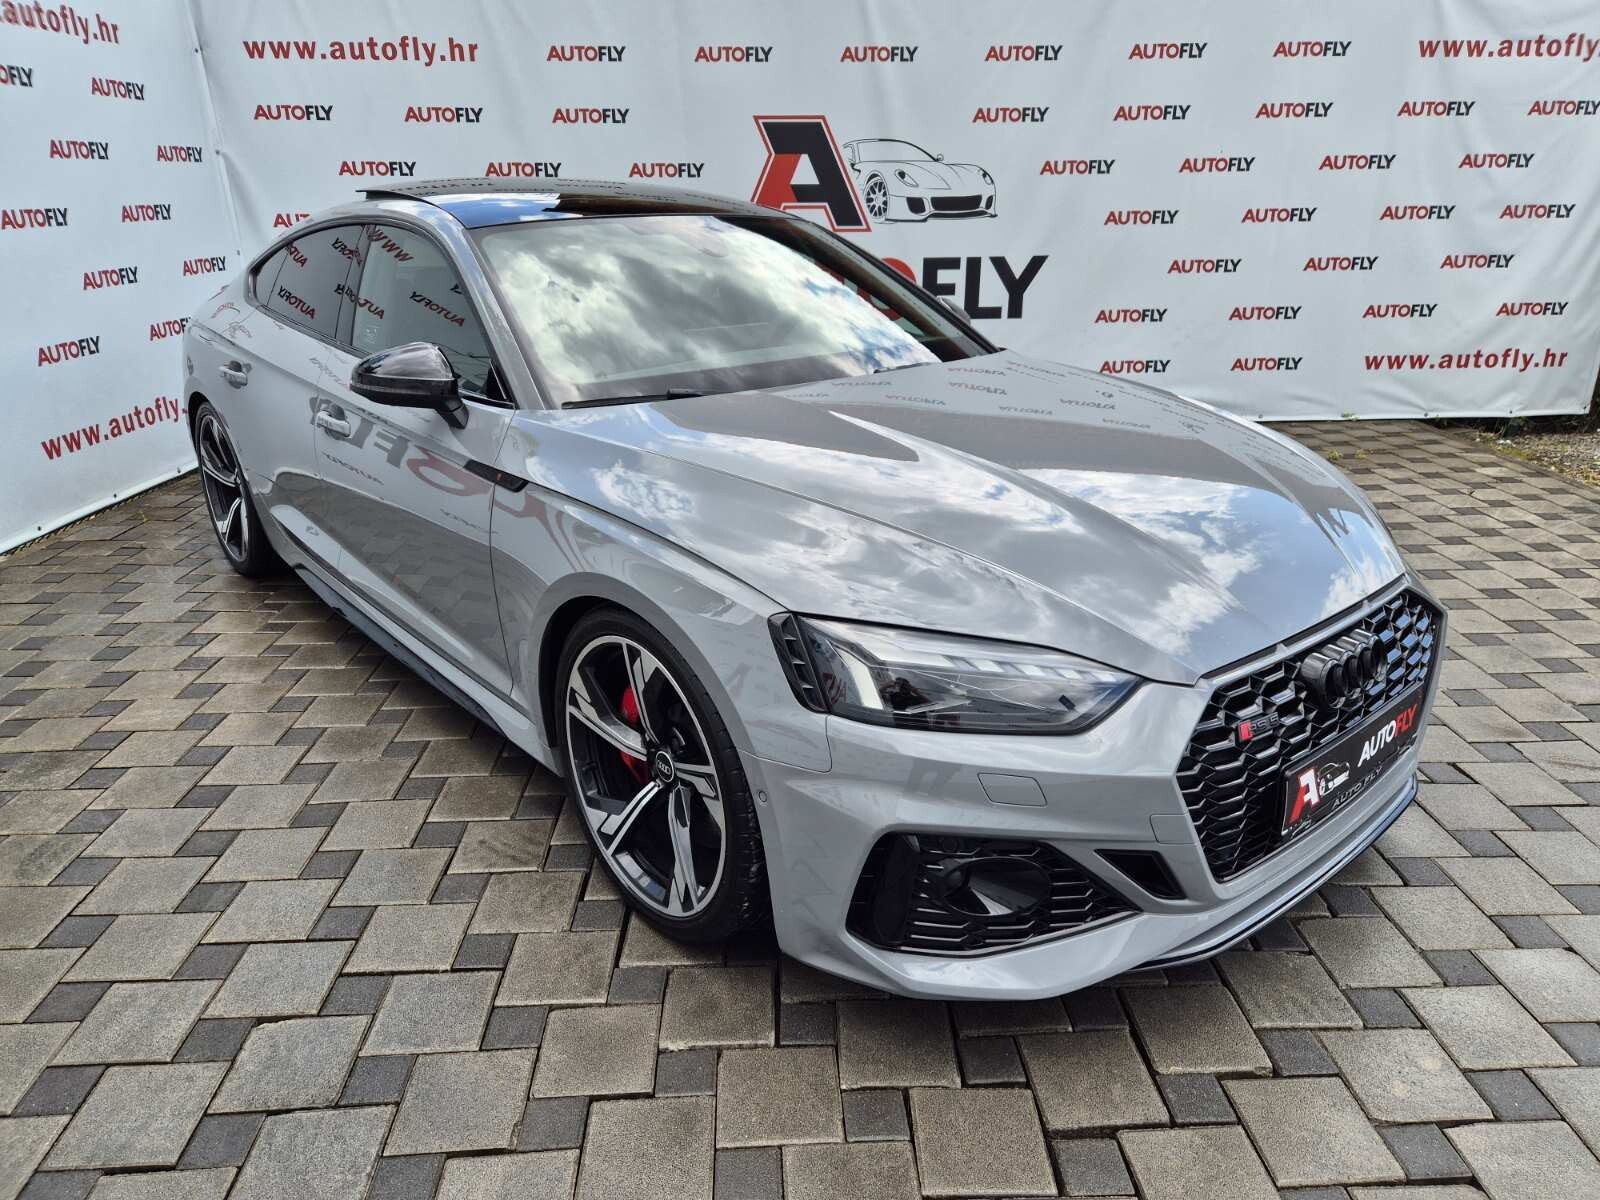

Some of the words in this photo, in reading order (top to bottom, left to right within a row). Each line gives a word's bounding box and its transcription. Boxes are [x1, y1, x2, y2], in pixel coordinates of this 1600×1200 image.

[243, 36, 478, 67] www.autofly.hr
[547, 46, 626, 62] AUTOFLY
[695, 46, 773, 62] AUTOFLY
[840, 46, 918, 62] AUTOFLY
[984, 45, 1063, 61] AUTOFLY
[1128, 43, 1208, 59] AUTOFLY
[1273, 41, 1352, 57] AUTOFLY
[92, 77, 144, 101] AUTOFLY
[254, 105, 333, 121] AUTOFLY
[404, 106, 483, 123] AUTOFLY
[972, 107, 1049, 123] AUTOFLY
[1113, 105, 1191, 121] AUTOFLY
[1256, 102, 1334, 118] AUTOFLY
[1397, 101, 1476, 116] AUTOFLY
[1528, 100, 1600, 115] AUTOFLY
[552, 108, 629, 124] AUTOFLY
[50, 140, 109, 160] AUTOFLY
[157, 145, 202, 162] AUTOFLY
[1040, 160, 1115, 175] AUTOFLY
[1179, 157, 1255, 173] AUTOFLY
[1318, 154, 1396, 170] AUTOFLY
[1458, 153, 1535, 168] AUTOFLY
[339, 161, 416, 177] AUTOFLY
[485, 162, 562, 178] AUTOFLY
[629, 163, 704, 178] AUTOFLY
[1, 208, 68, 230] AUTOFLY
[122, 204, 171, 222] AUTOFLY
[1104, 210, 1179, 225] AUTOFLY
[1241, 208, 1317, 223] AUTOFLY
[1379, 205, 1456, 220] AUTOFLY
[1499, 204, 1576, 219] AUTOFLY
[183, 256, 225, 276] AUTOFLY
[1168, 259, 1242, 274] AUTOFLY
[1303, 256, 1379, 271] AUTOFLY
[1440, 254, 1515, 269] AUTOFLY
[83, 266, 138, 290] AUTOFLY
[1094, 309, 1167, 323] AUTOFLY
[1229, 306, 1302, 320] AUTOFLY
[1362, 304, 1438, 318] AUTOFLY
[1496, 302, 1568, 316] AUTOFLY
[38, 336, 99, 367] AUTOFLY
[1100, 360, 1171, 375] AUTOFLY
[1230, 357, 1303, 371] AUTOFLY
[1365, 348, 1568, 372] www.autofly.hr
[1357, 703, 1418, 768] AUTOFLY
